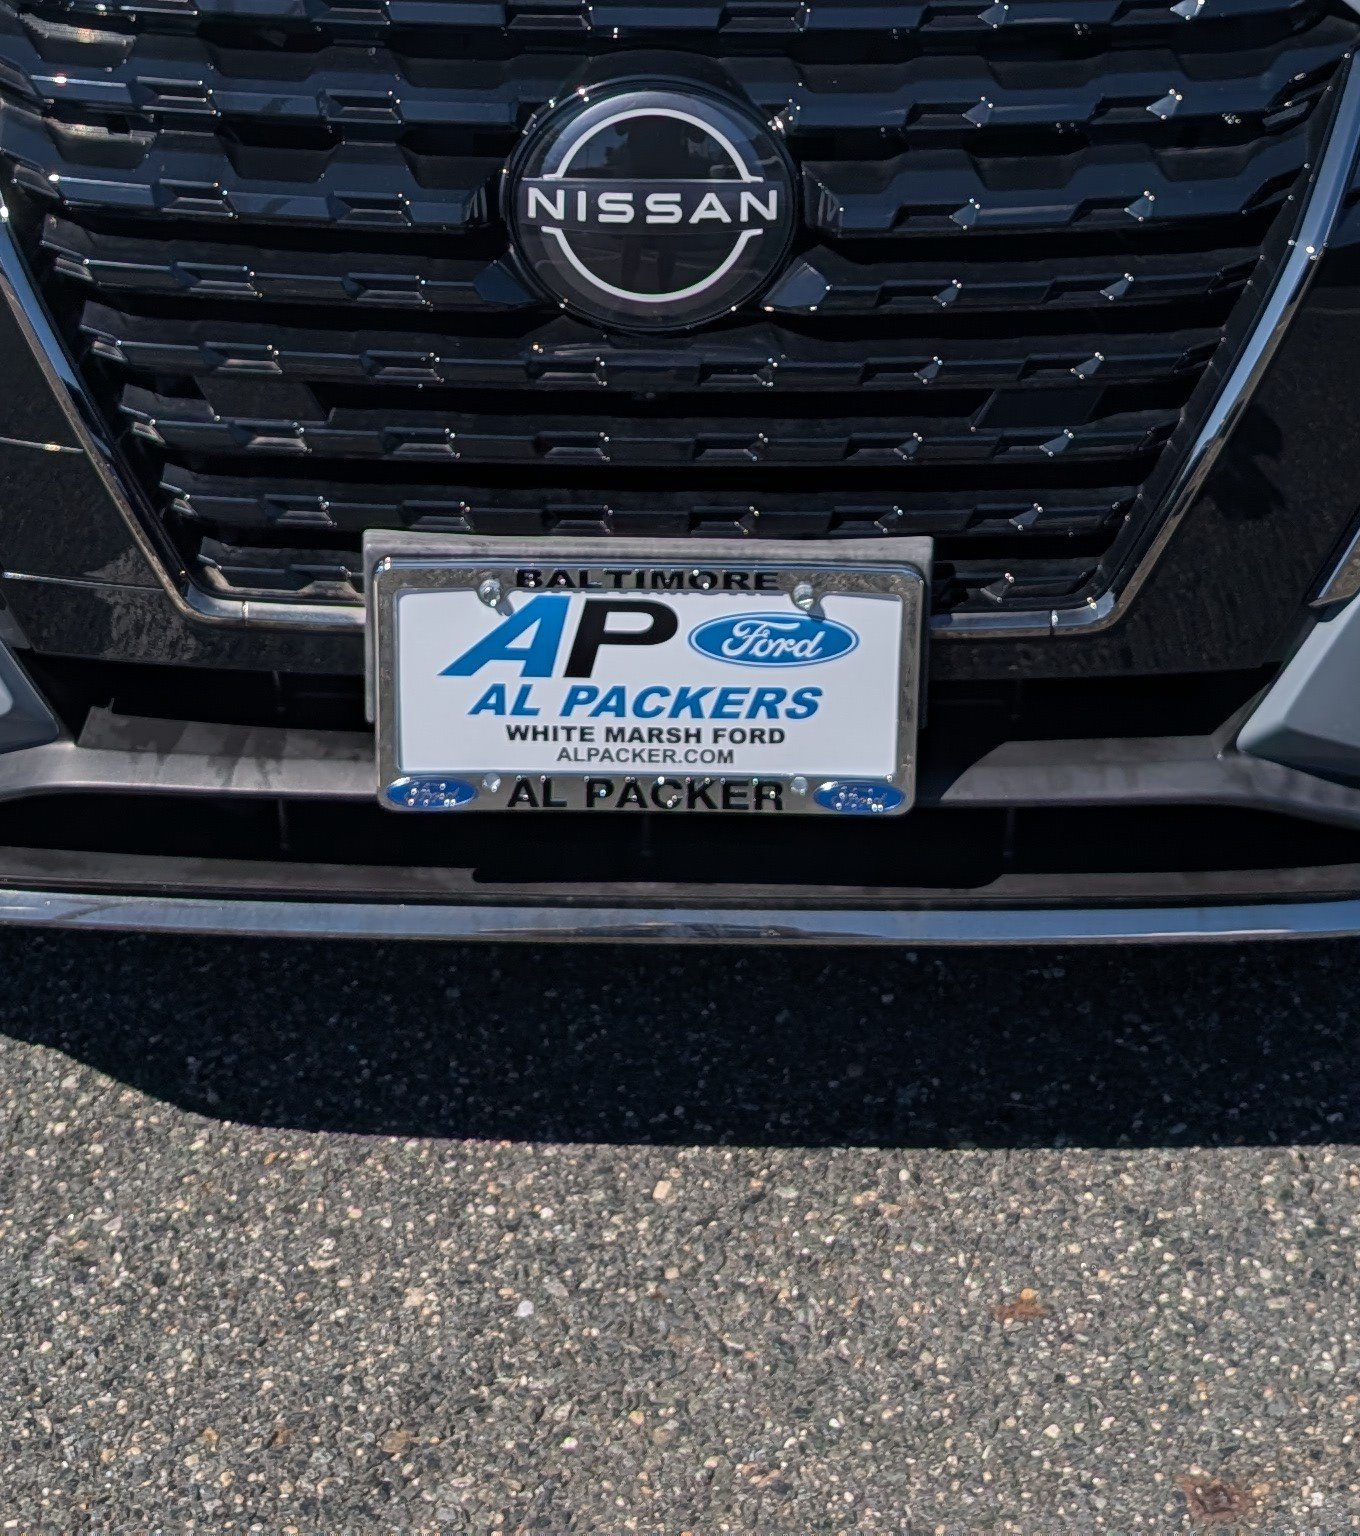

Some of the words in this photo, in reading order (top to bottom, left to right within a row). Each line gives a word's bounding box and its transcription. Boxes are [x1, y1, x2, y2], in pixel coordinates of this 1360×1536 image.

[527, 187, 778, 224] NISSAN
[515, 569, 780, 592] BALTIMORE
[437, 595, 679, 678] AP
[720, 619, 826, 660] Ford
[467, 683, 540, 717] AL
[559, 685, 824, 720] PACKERS
[506, 724, 594, 743] WHITE
[604, 725, 702, 744] MARSH
[712, 726, 786, 745] FORD
[556, 747, 735, 765] ALPACKER.COM
[506, 777, 568, 809] AL
[586, 778, 784, 812] PACKER
